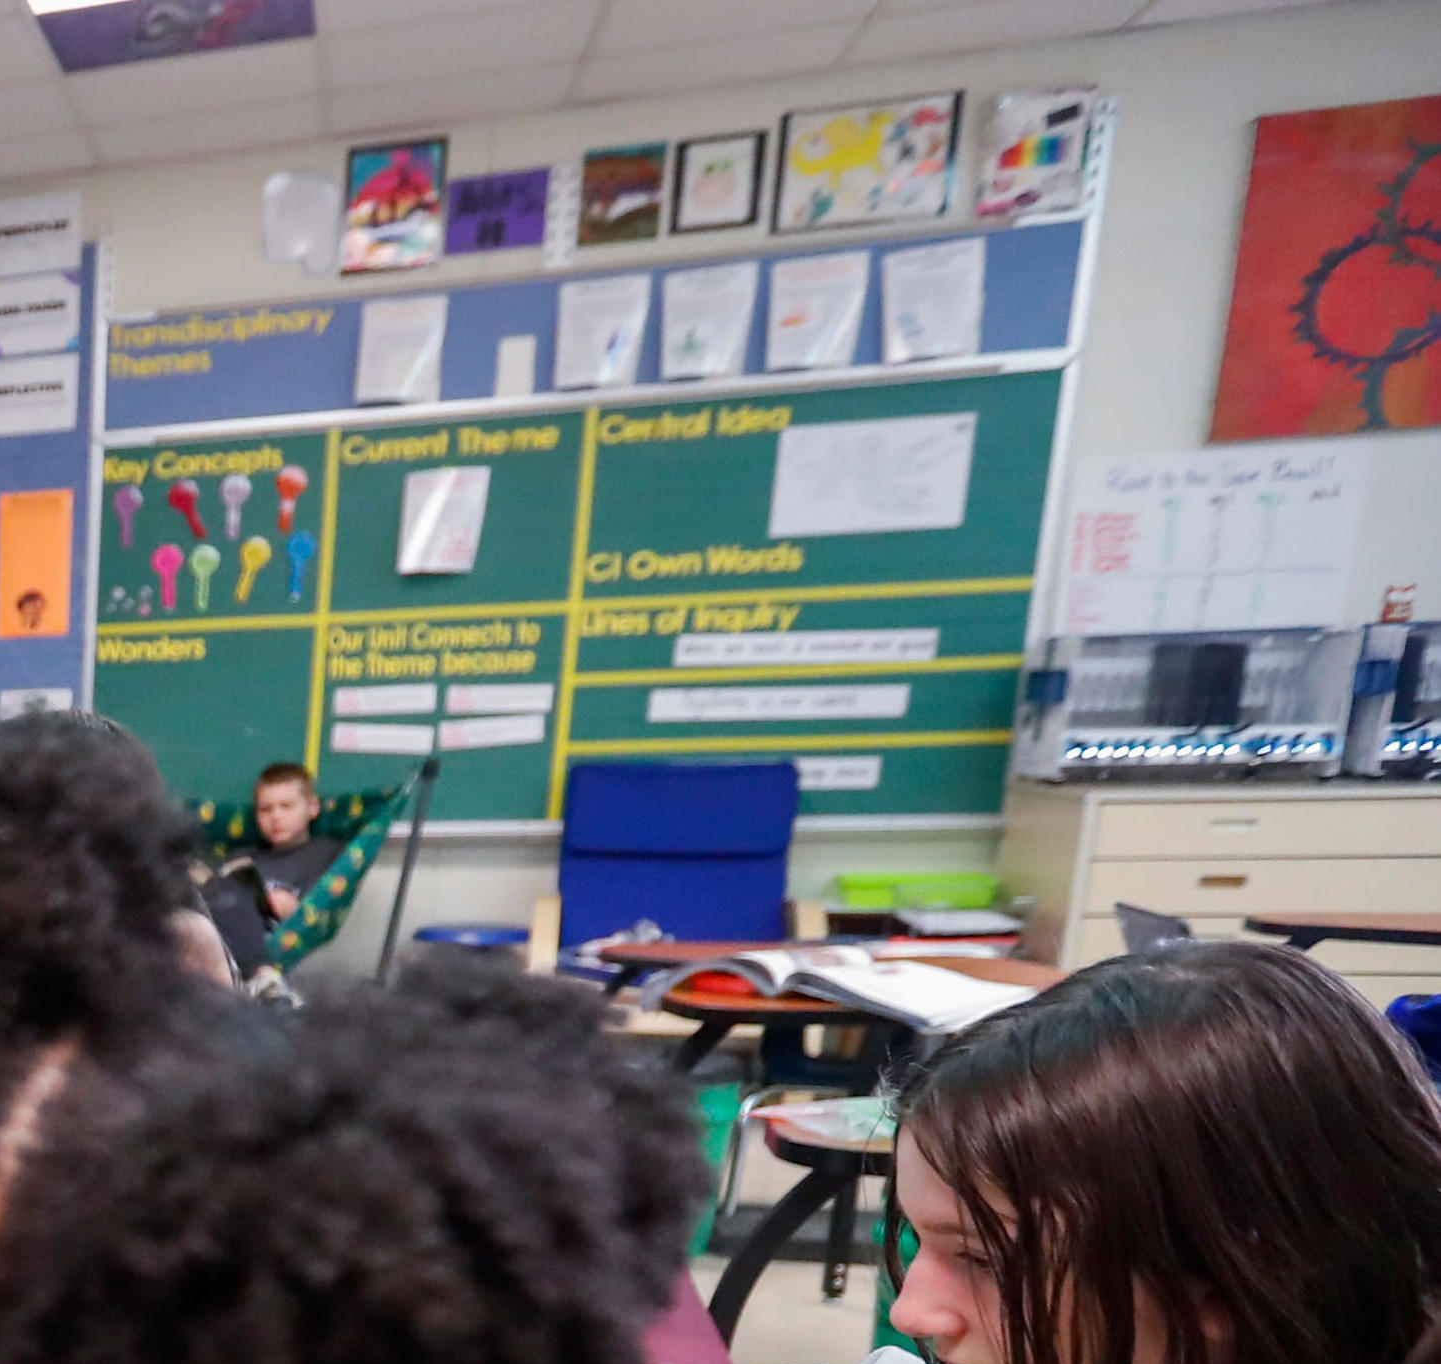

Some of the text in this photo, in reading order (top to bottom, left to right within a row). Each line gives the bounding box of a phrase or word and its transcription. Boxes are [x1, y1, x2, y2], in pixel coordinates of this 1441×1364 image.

[109, 306, 335, 349] Transdisciplinary
[109, 349, 213, 380] Themes
[599, 405, 793, 446] Central Idea
[342, 424, 561, 466] Current Theme
[102, 445, 285, 487] Key Concepts
[628, 548, 703, 581] Own
[706, 541, 804, 576] Words
[328, 620, 542, 653] Our Unit Connects to
[582, 602, 801, 638] Lines of Inquiry
[97, 635, 207, 663] Wonders
[328, 649, 538, 678] the Theme because
